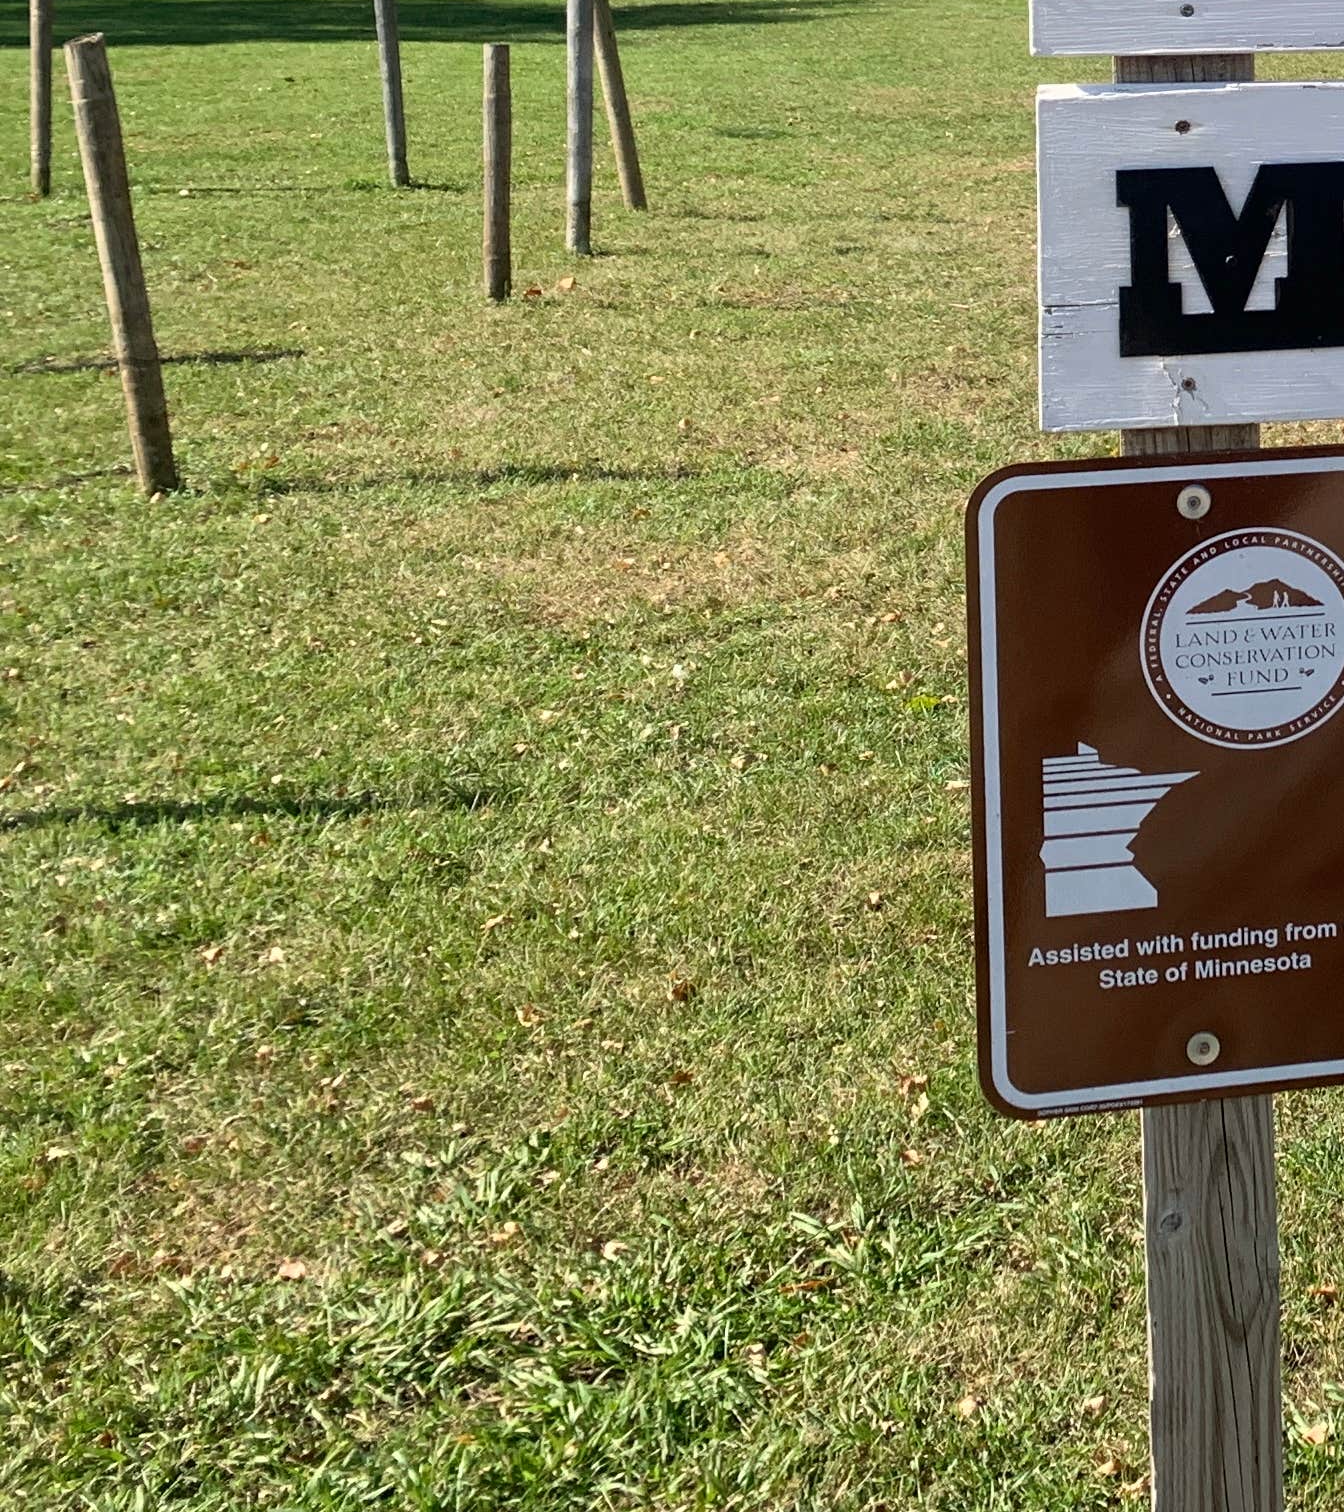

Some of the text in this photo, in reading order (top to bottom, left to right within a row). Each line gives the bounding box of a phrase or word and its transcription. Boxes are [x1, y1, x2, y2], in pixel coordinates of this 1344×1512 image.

[1160, 567, 1189, 602] STATE
[1193, 546, 1217, 566] AND
[1224, 536, 1266, 549] LOCAL
[1175, 622, 1336, 648] LAND & WATER
[1175, 643, 1336, 669] CONSERVATION
[1227, 668, 1289, 686] FUND
[1178, 695, 1336, 741] NATIONAL PARK SERVICE
[1028, 939, 1129, 967] Assisted
[1136, 933, 1184, 956] with
[1190, 926, 1279, 951] funding
[1285, 921, 1337, 941] from
[1099, 952, 1312, 989] State of Minnesota
